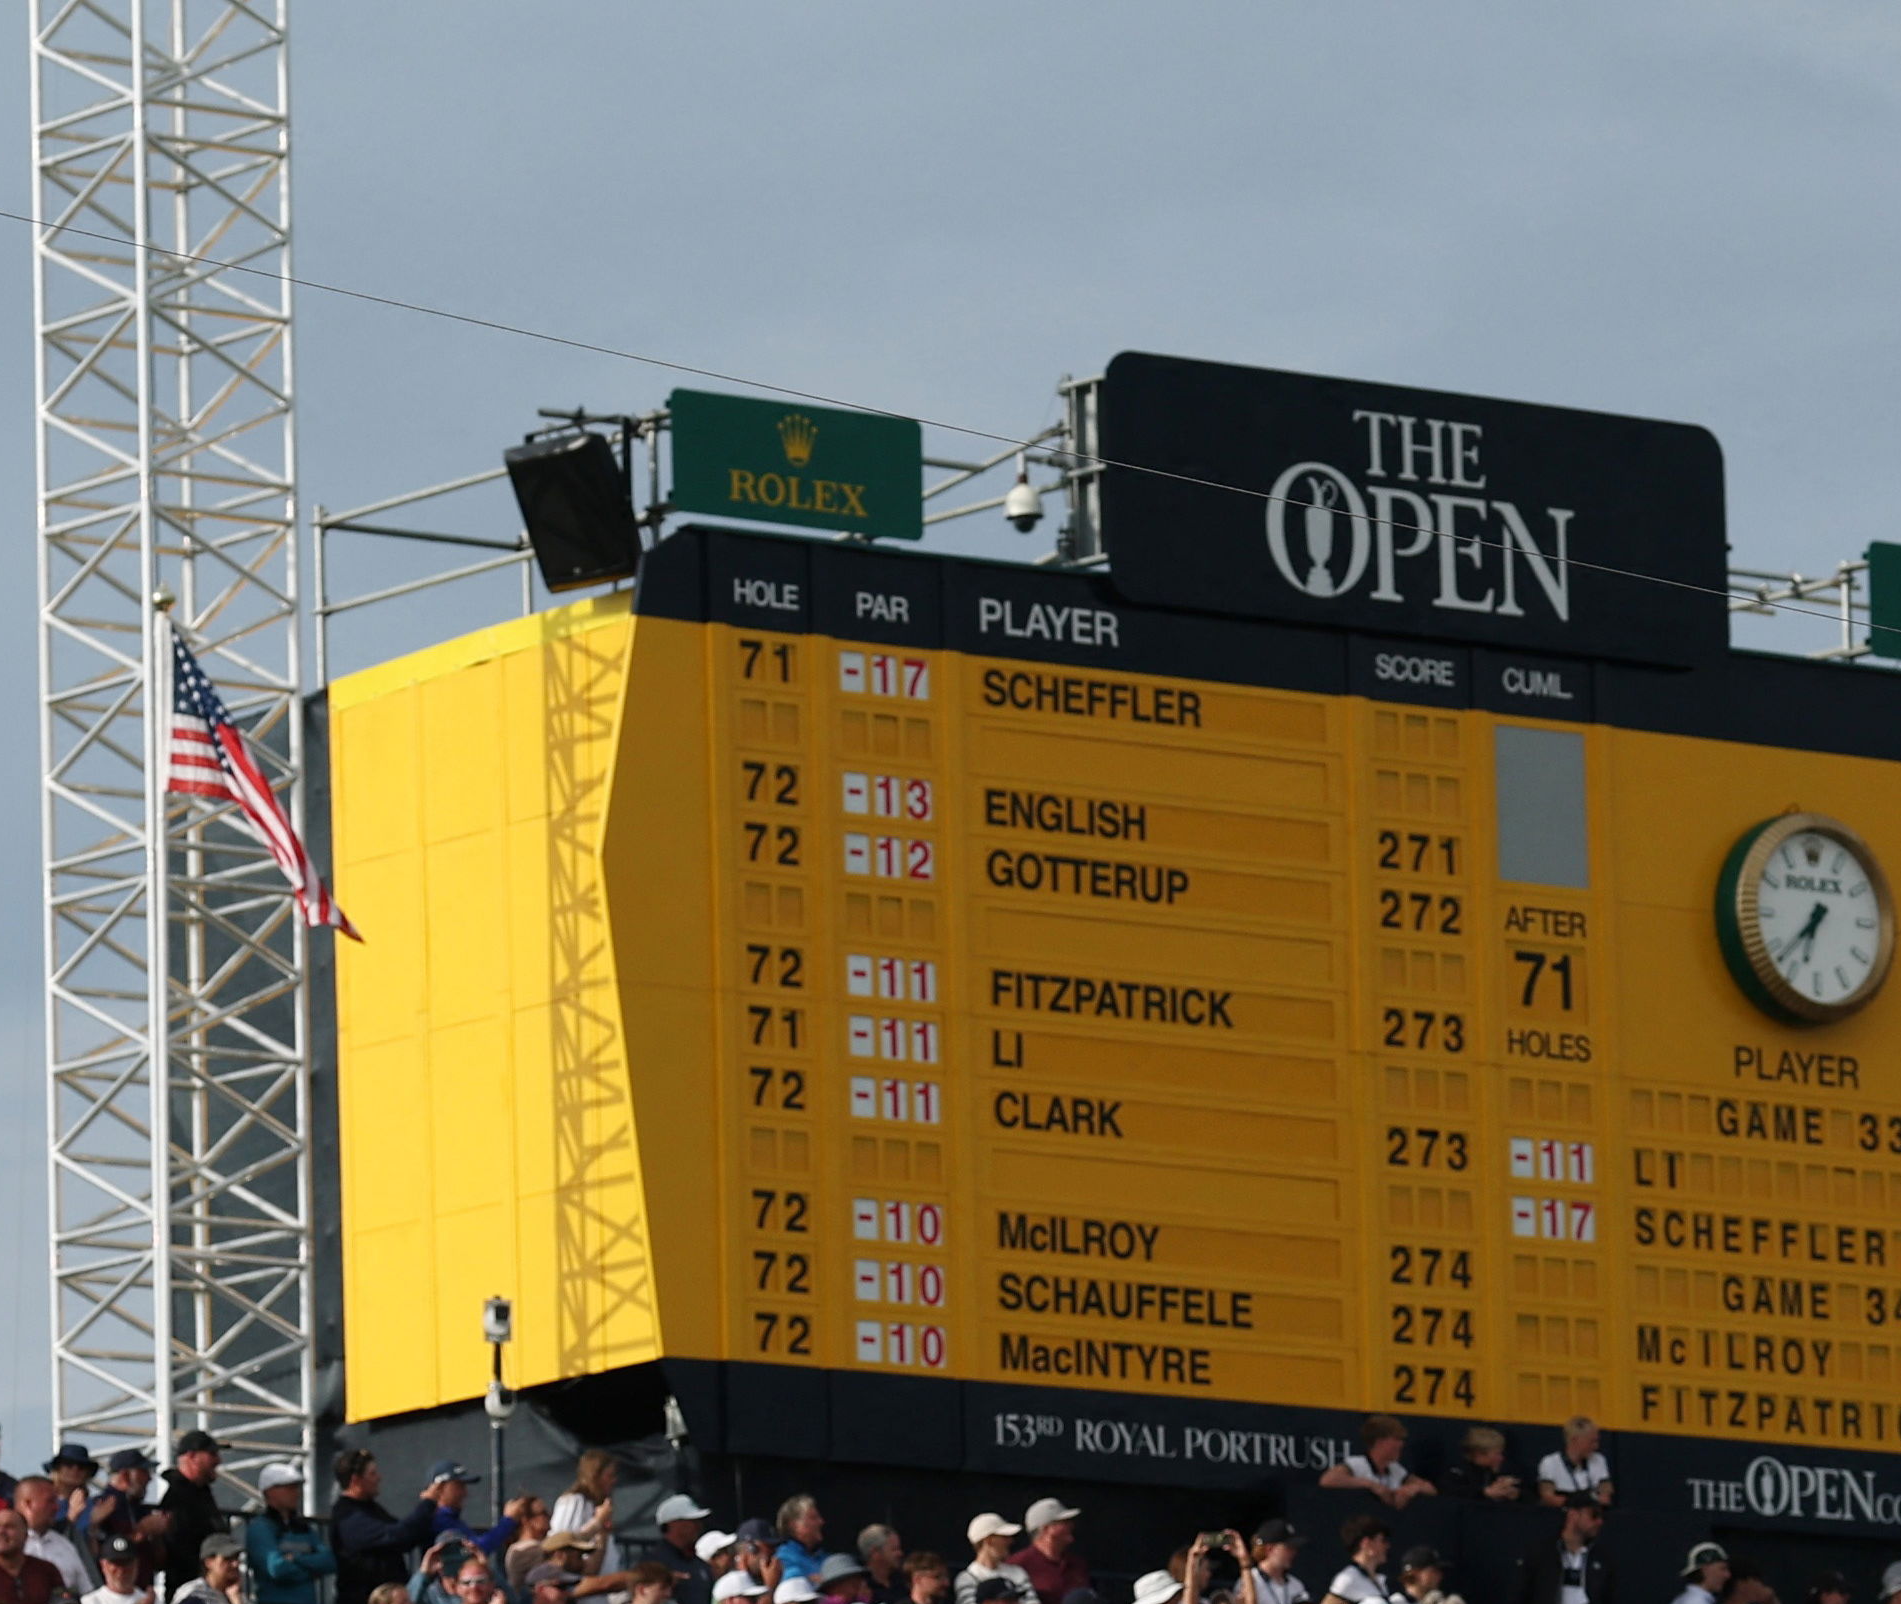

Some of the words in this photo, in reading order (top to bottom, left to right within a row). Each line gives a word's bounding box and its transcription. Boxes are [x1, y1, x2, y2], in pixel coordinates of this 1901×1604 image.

[1353, 409, 1487, 490] THE
[728, 468, 869, 518] ROLEX
[1266, 461, 1575, 622] OPEN
[733, 577, 799, 612] HOLE
[855, 591, 910, 624] PAR
[979, 597, 1119, 648] PLAYER
[1374, 653, 1455, 688] SCORE
[739, 640, 790, 684] 71
[845, 653, 928, 698] -17
[984, 668, 1201, 728] SCHEFFLER
[742, 761, 799, 805] 72
[847, 776, 931, 822] -13
[985, 788, 1147, 842] ENGLISH
[1378, 830, 1457, 876] 271
[744, 823, 800, 866] 72
[849, 837, 933, 882] -12
[987, 849, 1190, 904] GOTTERUP
[1381, 889, 1462, 935] 272
[1785, 873, 1843, 895] ROLEX
[1504, 904, 1588, 938] AFTER
[747, 944, 802, 988] 72
[852, 957, 932, 1001] -11
[991, 969, 1235, 1028] FITZPATRICK
[1384, 1008, 1465, 1053] 273
[1514, 950, 1574, 1011] 71
[748, 1005, 800, 1049] 71
[853, 1018, 933, 1063] -11
[992, 1029, 1025, 1068] LI
[1508, 1027, 1592, 1063] HOLES
[1734, 1045, 1860, 1089] PLAYER
[749, 1067, 804, 1110] 72
[854, 1079, 934, 1124] -11
[994, 1091, 1124, 1138] CLARK
[1387, 1127, 1468, 1172] 273
[1717, 1098, 1825, 1146] GAME
[1514, 1139, 1588, 1184] -11
[1633, 1148, 1678, 1189] LI
[752, 1189, 809, 1233] 72
[857, 1201, 941, 1246] -10
[998, 1211, 1161, 1261] McILROY
[1390, 1244, 1473, 1289] 274
[1516, 1200, 1594, 1242] -17
[1635, 1207, 1885, 1267] SCHEFFLER
[753, 1250, 811, 1294] 72
[859, 1262, 943, 1307] -10
[998, 1271, 1254, 1329] SCHAUFFELE
[1392, 1304, 1475, 1349] 274
[1723, 1275, 1831, 1320] GAME
[755, 1312, 812, 1355] 72
[860, 1323, 946, 1368] -10
[1000, 1332, 1212, 1385] MacINTYRE
[1394, 1364, 1476, 1408] 274
[1637, 1324, 1833, 1377] McILROY
[1074, 1418, 1177, 1459] ROYAL
[1184, 1425, 1353, 1469] PORTRUSH
